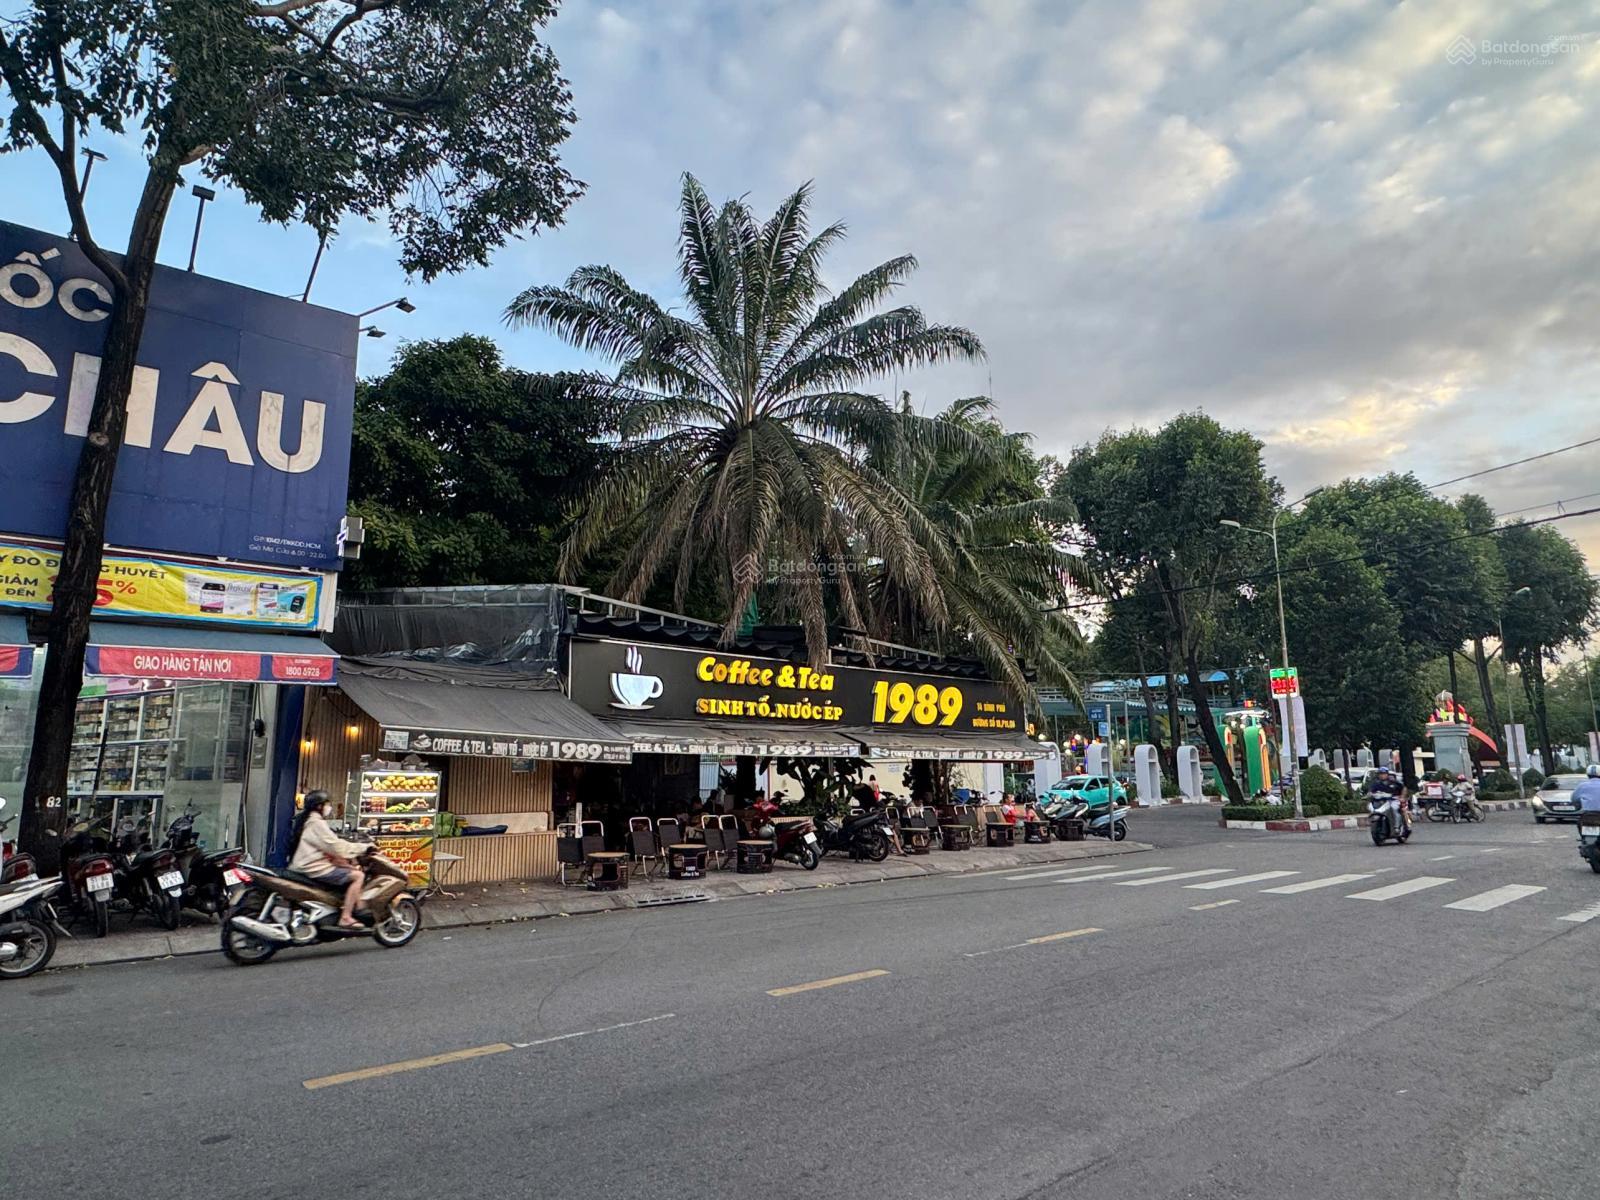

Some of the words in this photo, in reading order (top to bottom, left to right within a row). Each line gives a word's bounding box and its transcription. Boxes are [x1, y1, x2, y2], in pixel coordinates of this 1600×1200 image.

[12, 556, 40, 566] ĐO
[134, 655, 160, 670] GIAO
[162, 653, 190, 671] HÀNG
[193, 654, 213, 676] TẬN
[697, 656, 773, 686] Coffee
[776, 665, 796, 688] &
[798, 666, 834, 690] Tea
[696, 698, 744, 715] SINH
[823, 700, 843, 721] ÉP
[872, 680, 963, 725] 1989
[432, 738, 462, 752] COFFEE
[463, 740, 470, 753] &
[471, 741, 486, 754] TEA
[550, 741, 602, 760] 1989
[663, 744, 681, 753] TEA
[757, 744, 812, 756] 1989
[986, 750, 1024, 760] 1989
[46, 796, 61, 807] 82
